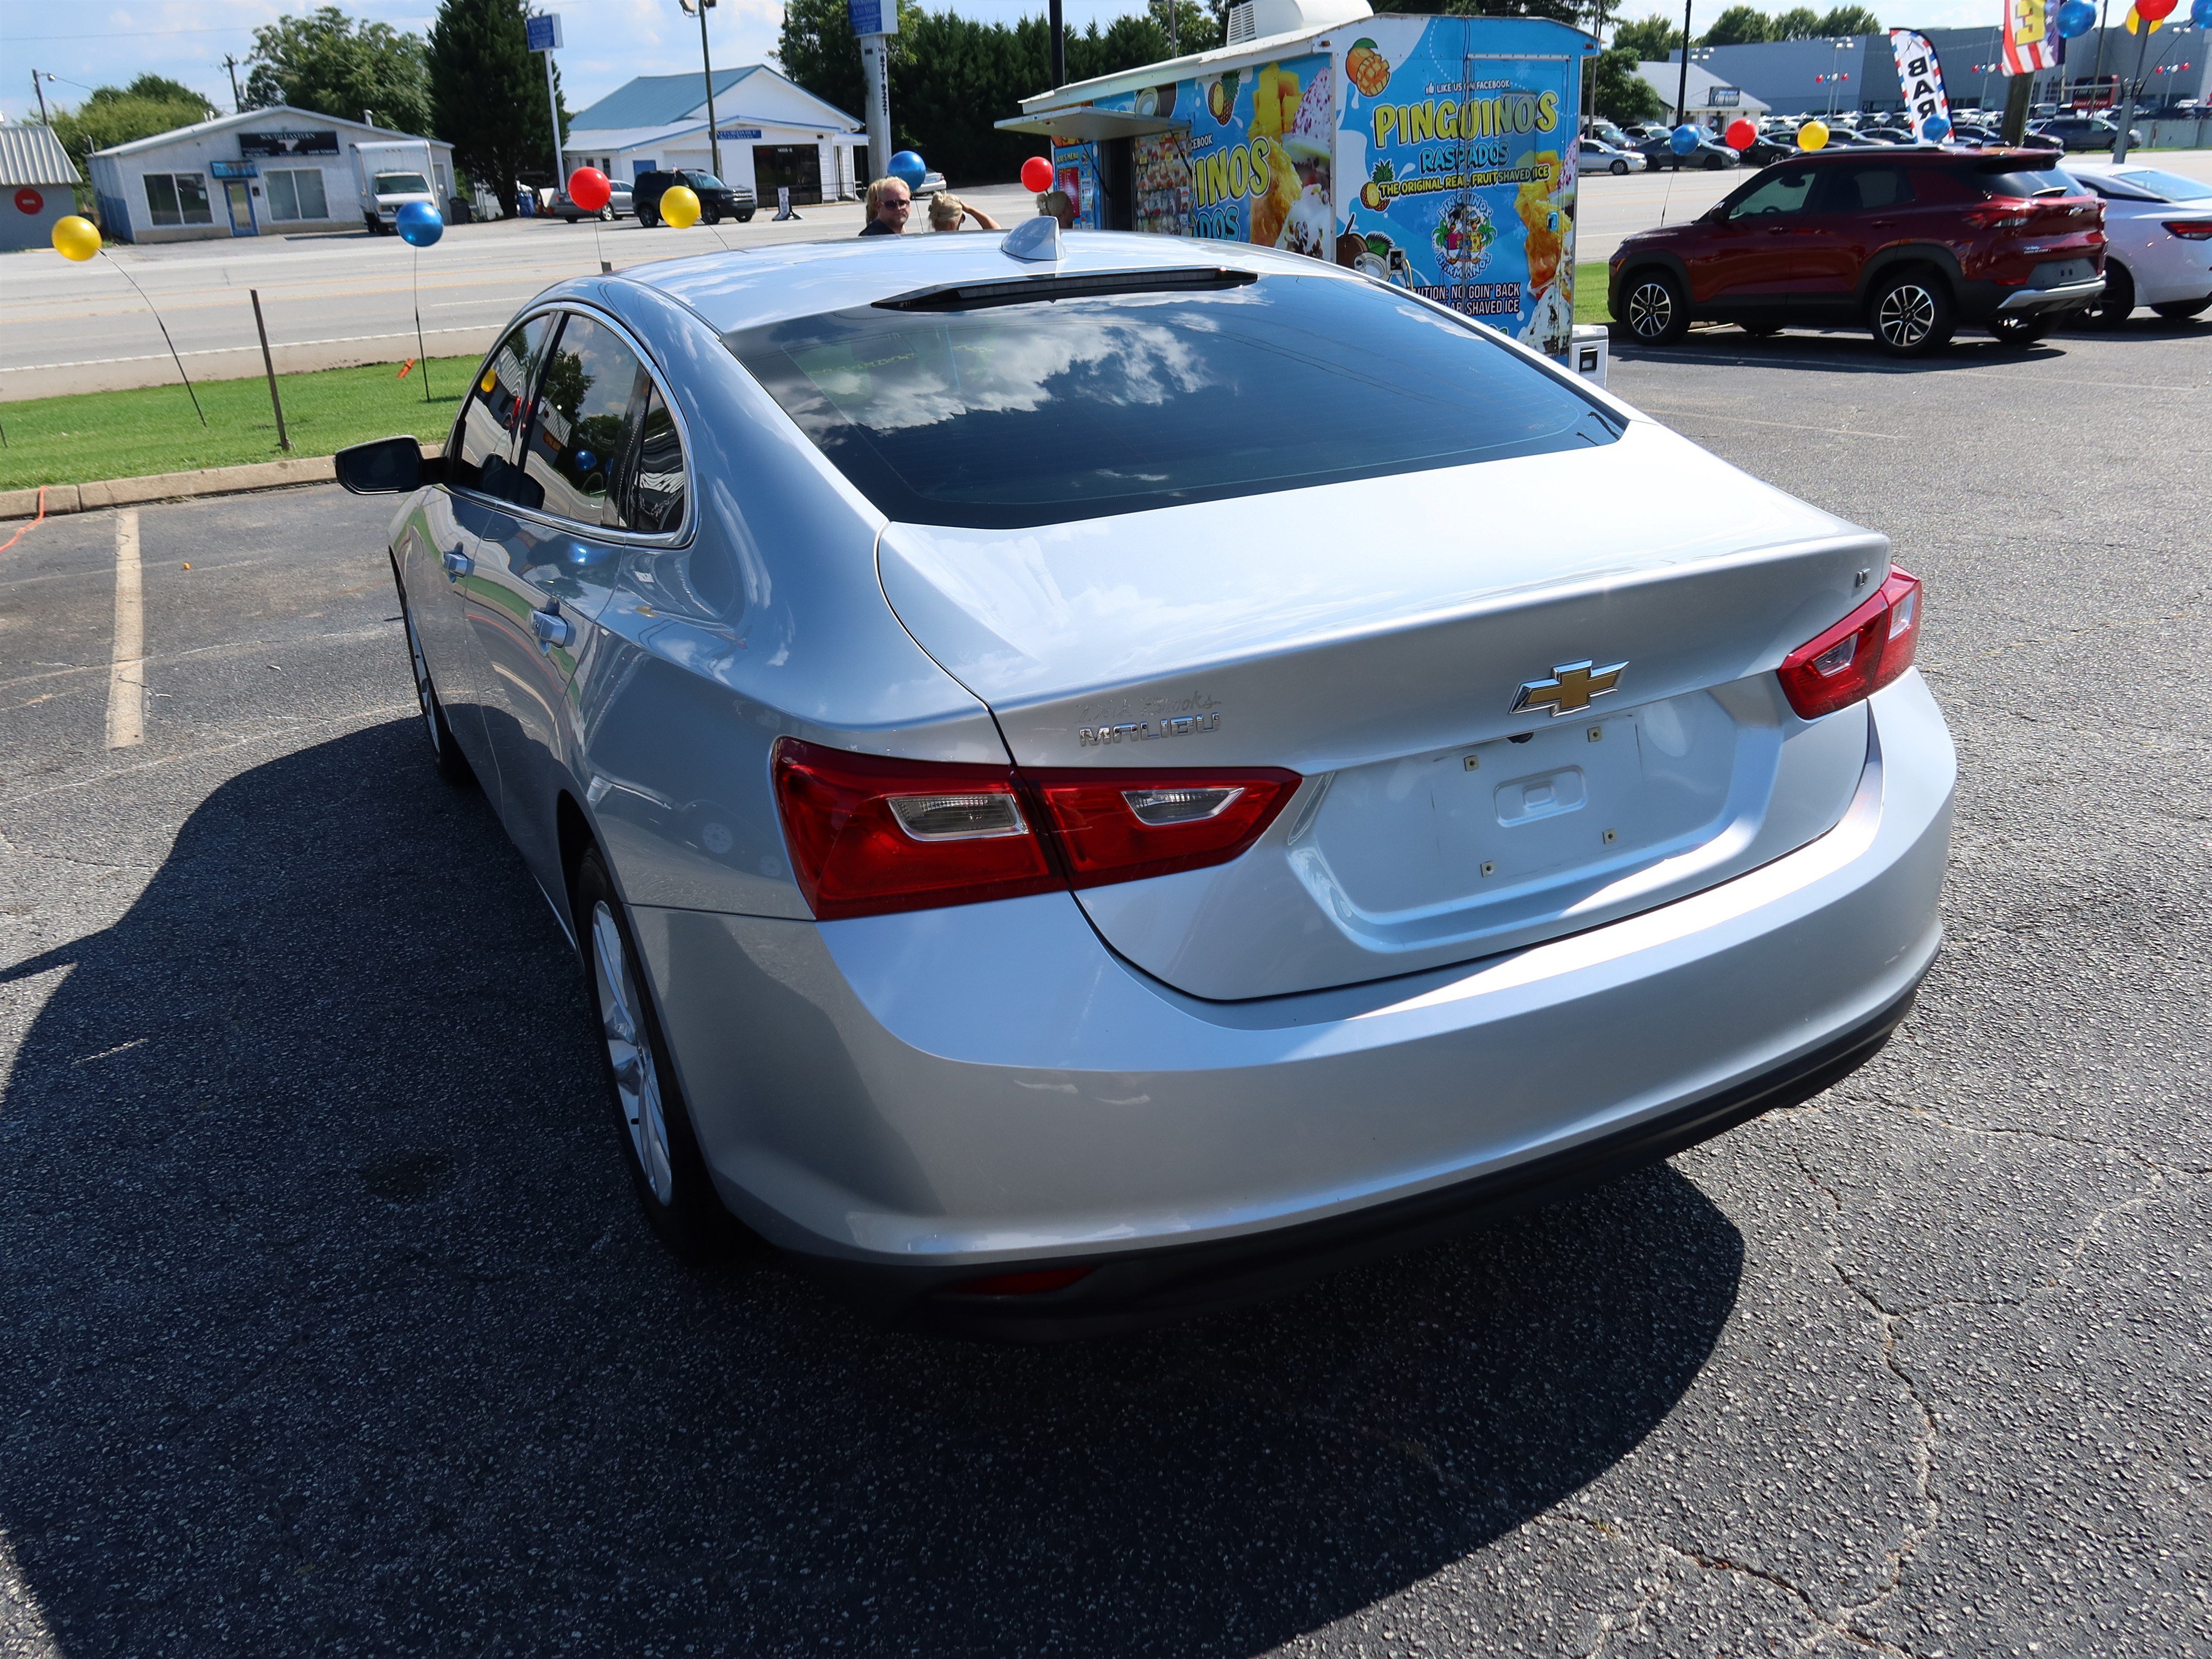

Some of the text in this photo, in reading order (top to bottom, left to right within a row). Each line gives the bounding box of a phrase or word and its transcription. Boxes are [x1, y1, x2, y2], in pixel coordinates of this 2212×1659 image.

[1436, 83, 1452, 93] LIKE
[1453, 82, 1462, 92] US
[1476, 79, 1511, 91] FACEBOOK
[1373, 91, 1559, 149] PINGUINOS
[1420, 141, 1510, 173] RASPADOS
[1380, 165, 1549, 197] THE ORIGINAL REA FRUIT SHAVED ICE
[1452, 285, 1465, 298] NO
[1469, 284, 1493, 299] GOIN'
[1496, 283, 1520, 296] BACK
[1467, 300, 1503, 315] SHAVED
[1505, 299, 1519, 313] ICE
[1080, 712, 1220, 747] MALIBU
